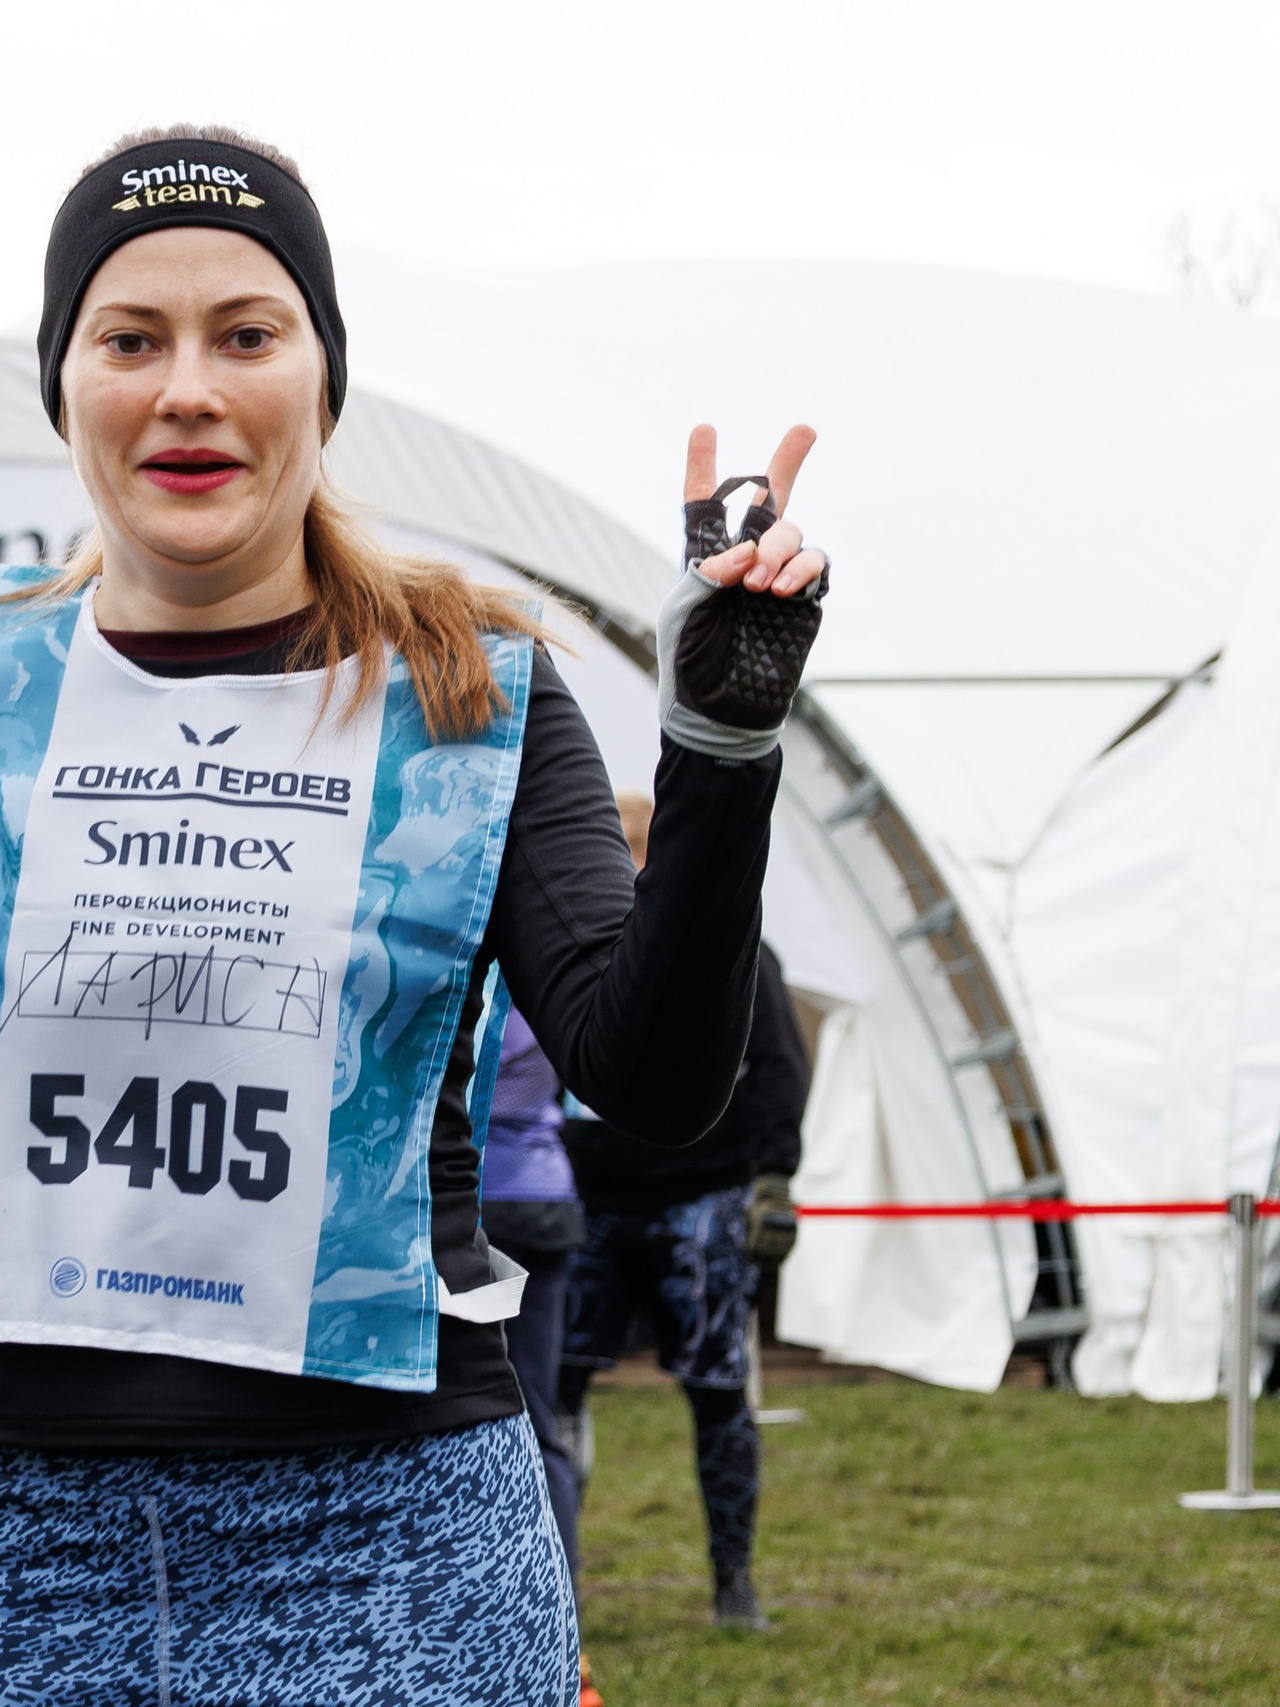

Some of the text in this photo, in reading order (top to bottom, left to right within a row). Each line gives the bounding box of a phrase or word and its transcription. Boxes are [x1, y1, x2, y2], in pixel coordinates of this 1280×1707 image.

[121, 159, 249, 195] Sminex
[144, 184, 233, 206] team
[53, 762, 352, 804] ГОНКА ГЕРОЕВ
[84, 819, 296, 873] Sminex
[73, 894, 290, 919] ПЕРФЕКЦИОНИСТЫ
[71, 921, 286, 946] FINE DEVELOPMENT
[27, 1073, 292, 1203] 5405
[96, 1267, 244, 1306] ГАЗПРОМБАНК
